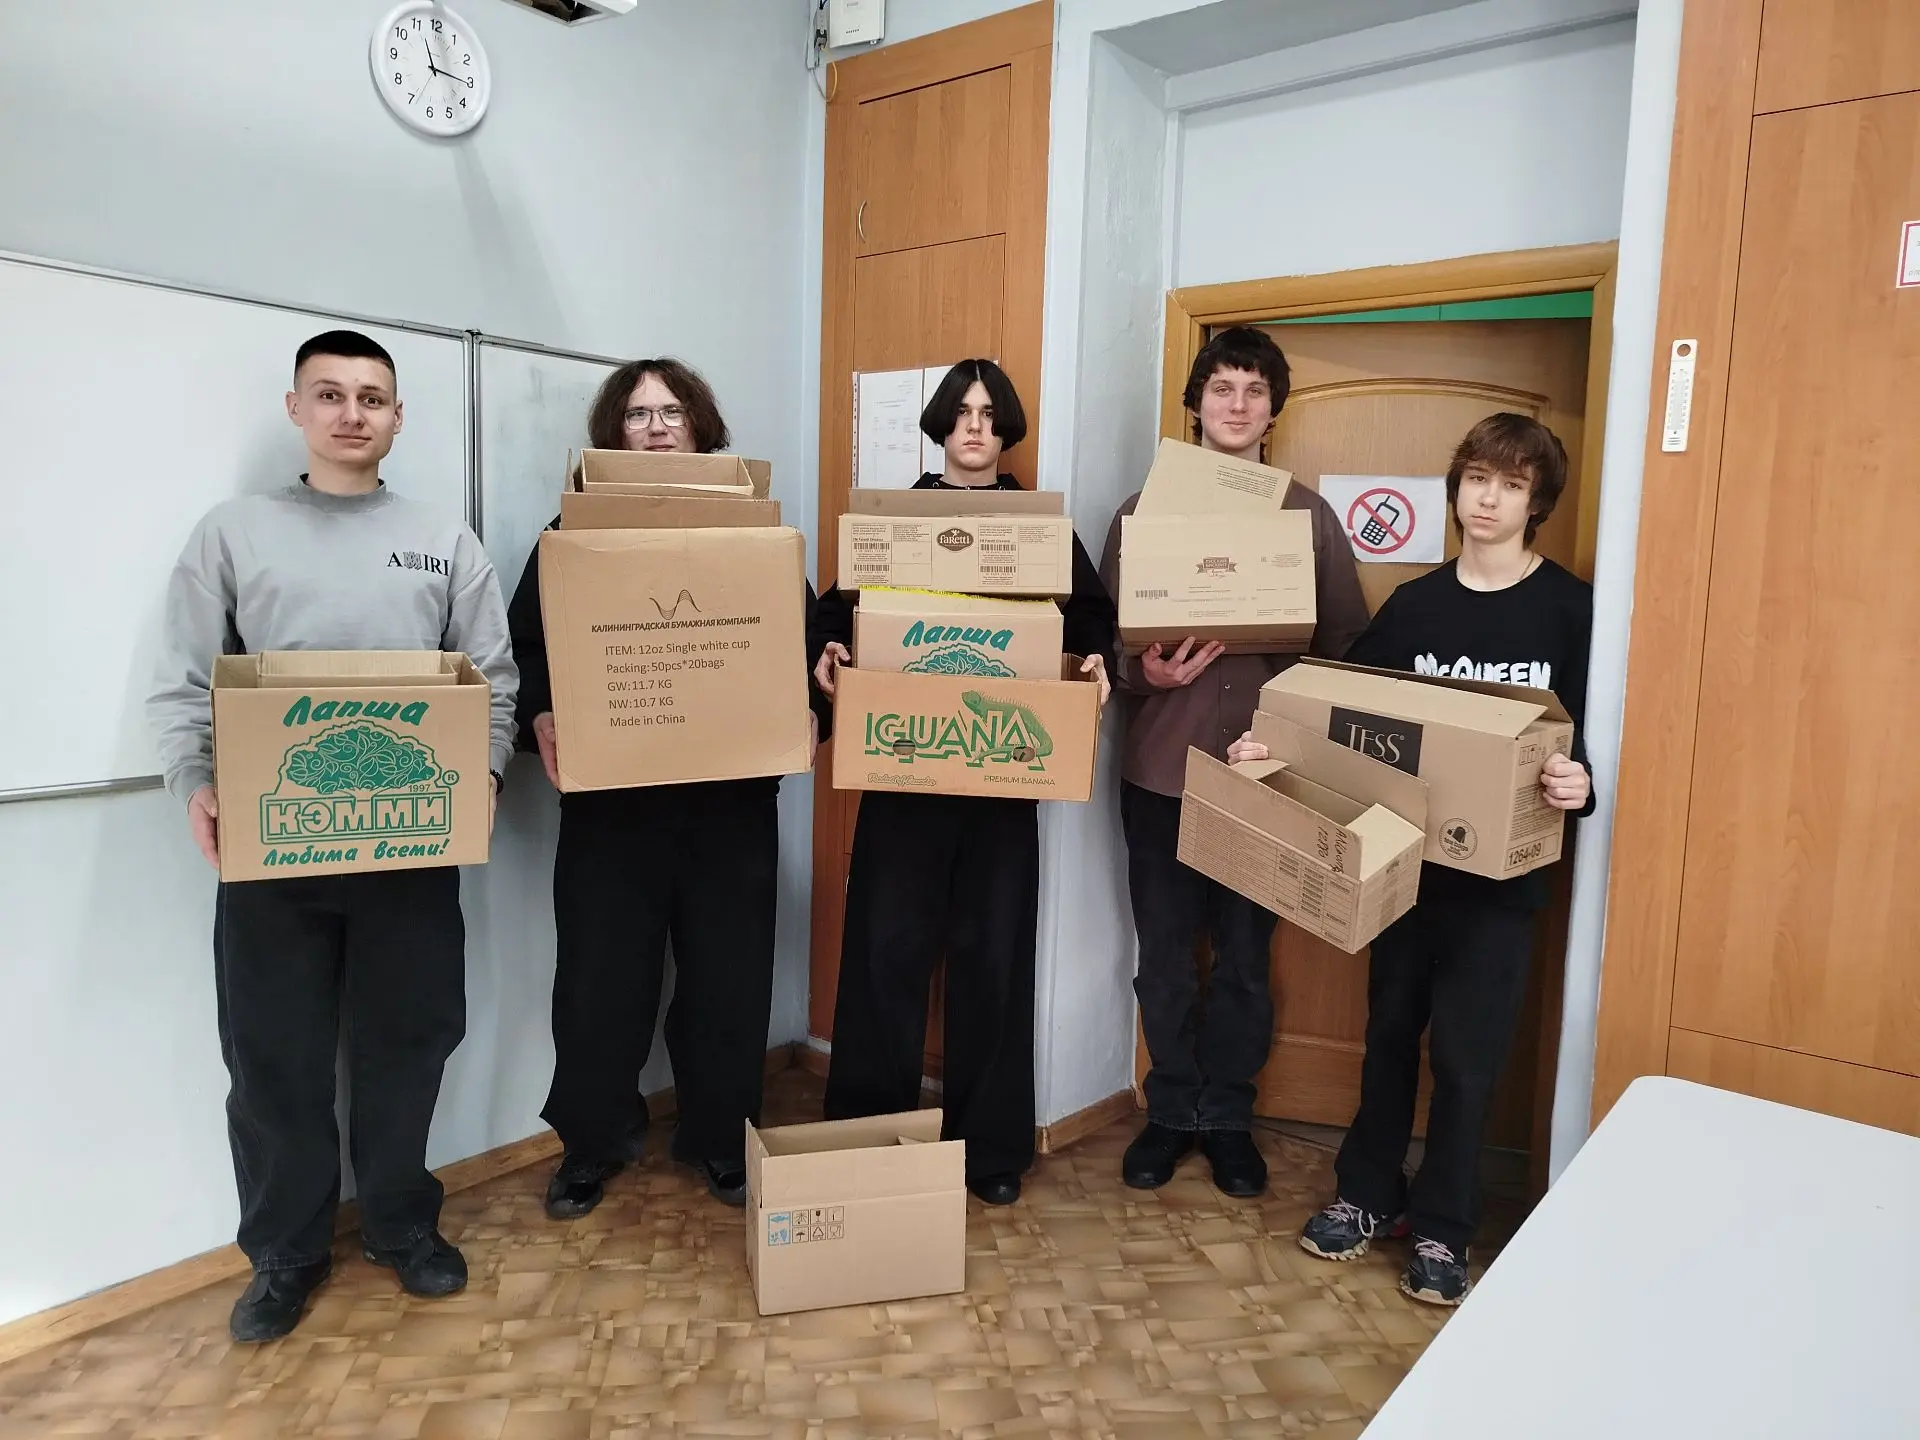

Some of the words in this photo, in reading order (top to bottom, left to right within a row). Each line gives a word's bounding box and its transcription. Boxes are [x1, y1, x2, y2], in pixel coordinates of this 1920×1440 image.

[411, 17, 422, 31] 11
[430, 18, 443, 34] 12
[395, 26, 408, 41] 10
[452, 34, 457, 46] 1
[389, 47, 398, 60] 9
[462, 53, 471, 66] 2
[394, 72, 403, 85] 8
[466, 76, 474, 89] 3
[407, 92, 415, 105] 7
[458, 97, 467, 109] 4
[426, 106, 434, 119] 6
[445, 106, 453, 119] 5
[591, 621, 670, 633] КАЛИНИНГРАДСКАЯ
[671, 619, 716, 630] БУМАЖНАЯ
[716, 616, 761, 627] КОМПАНИЯ
[902, 620, 1015, 652] Лапша
[605, 645, 636, 656] ITEM:
[639, 644, 663, 655] 12oz
[666, 642, 697, 655] Single
[700, 639, 729, 651] white
[731, 640, 750, 651] cup
[658, 679, 672, 689] KG
[659, 696, 674, 707] KG
[282, 695, 430, 727] Лапша
[610, 716, 641, 728] Made
[643, 715, 653, 726] in
[656, 714, 686, 725] China
[865, 709, 1045, 771] IGUANA
[1345, 722, 1400, 764] TESS
[983, 775, 1020, 785] PREMIUM
[1021, 777, 1056, 787] BANANA
[408, 783, 431, 793] 1997
[265, 795, 448, 836] КЭММИ
[262, 844, 359, 867] Любима
[373, 838, 450, 860] всеми!
